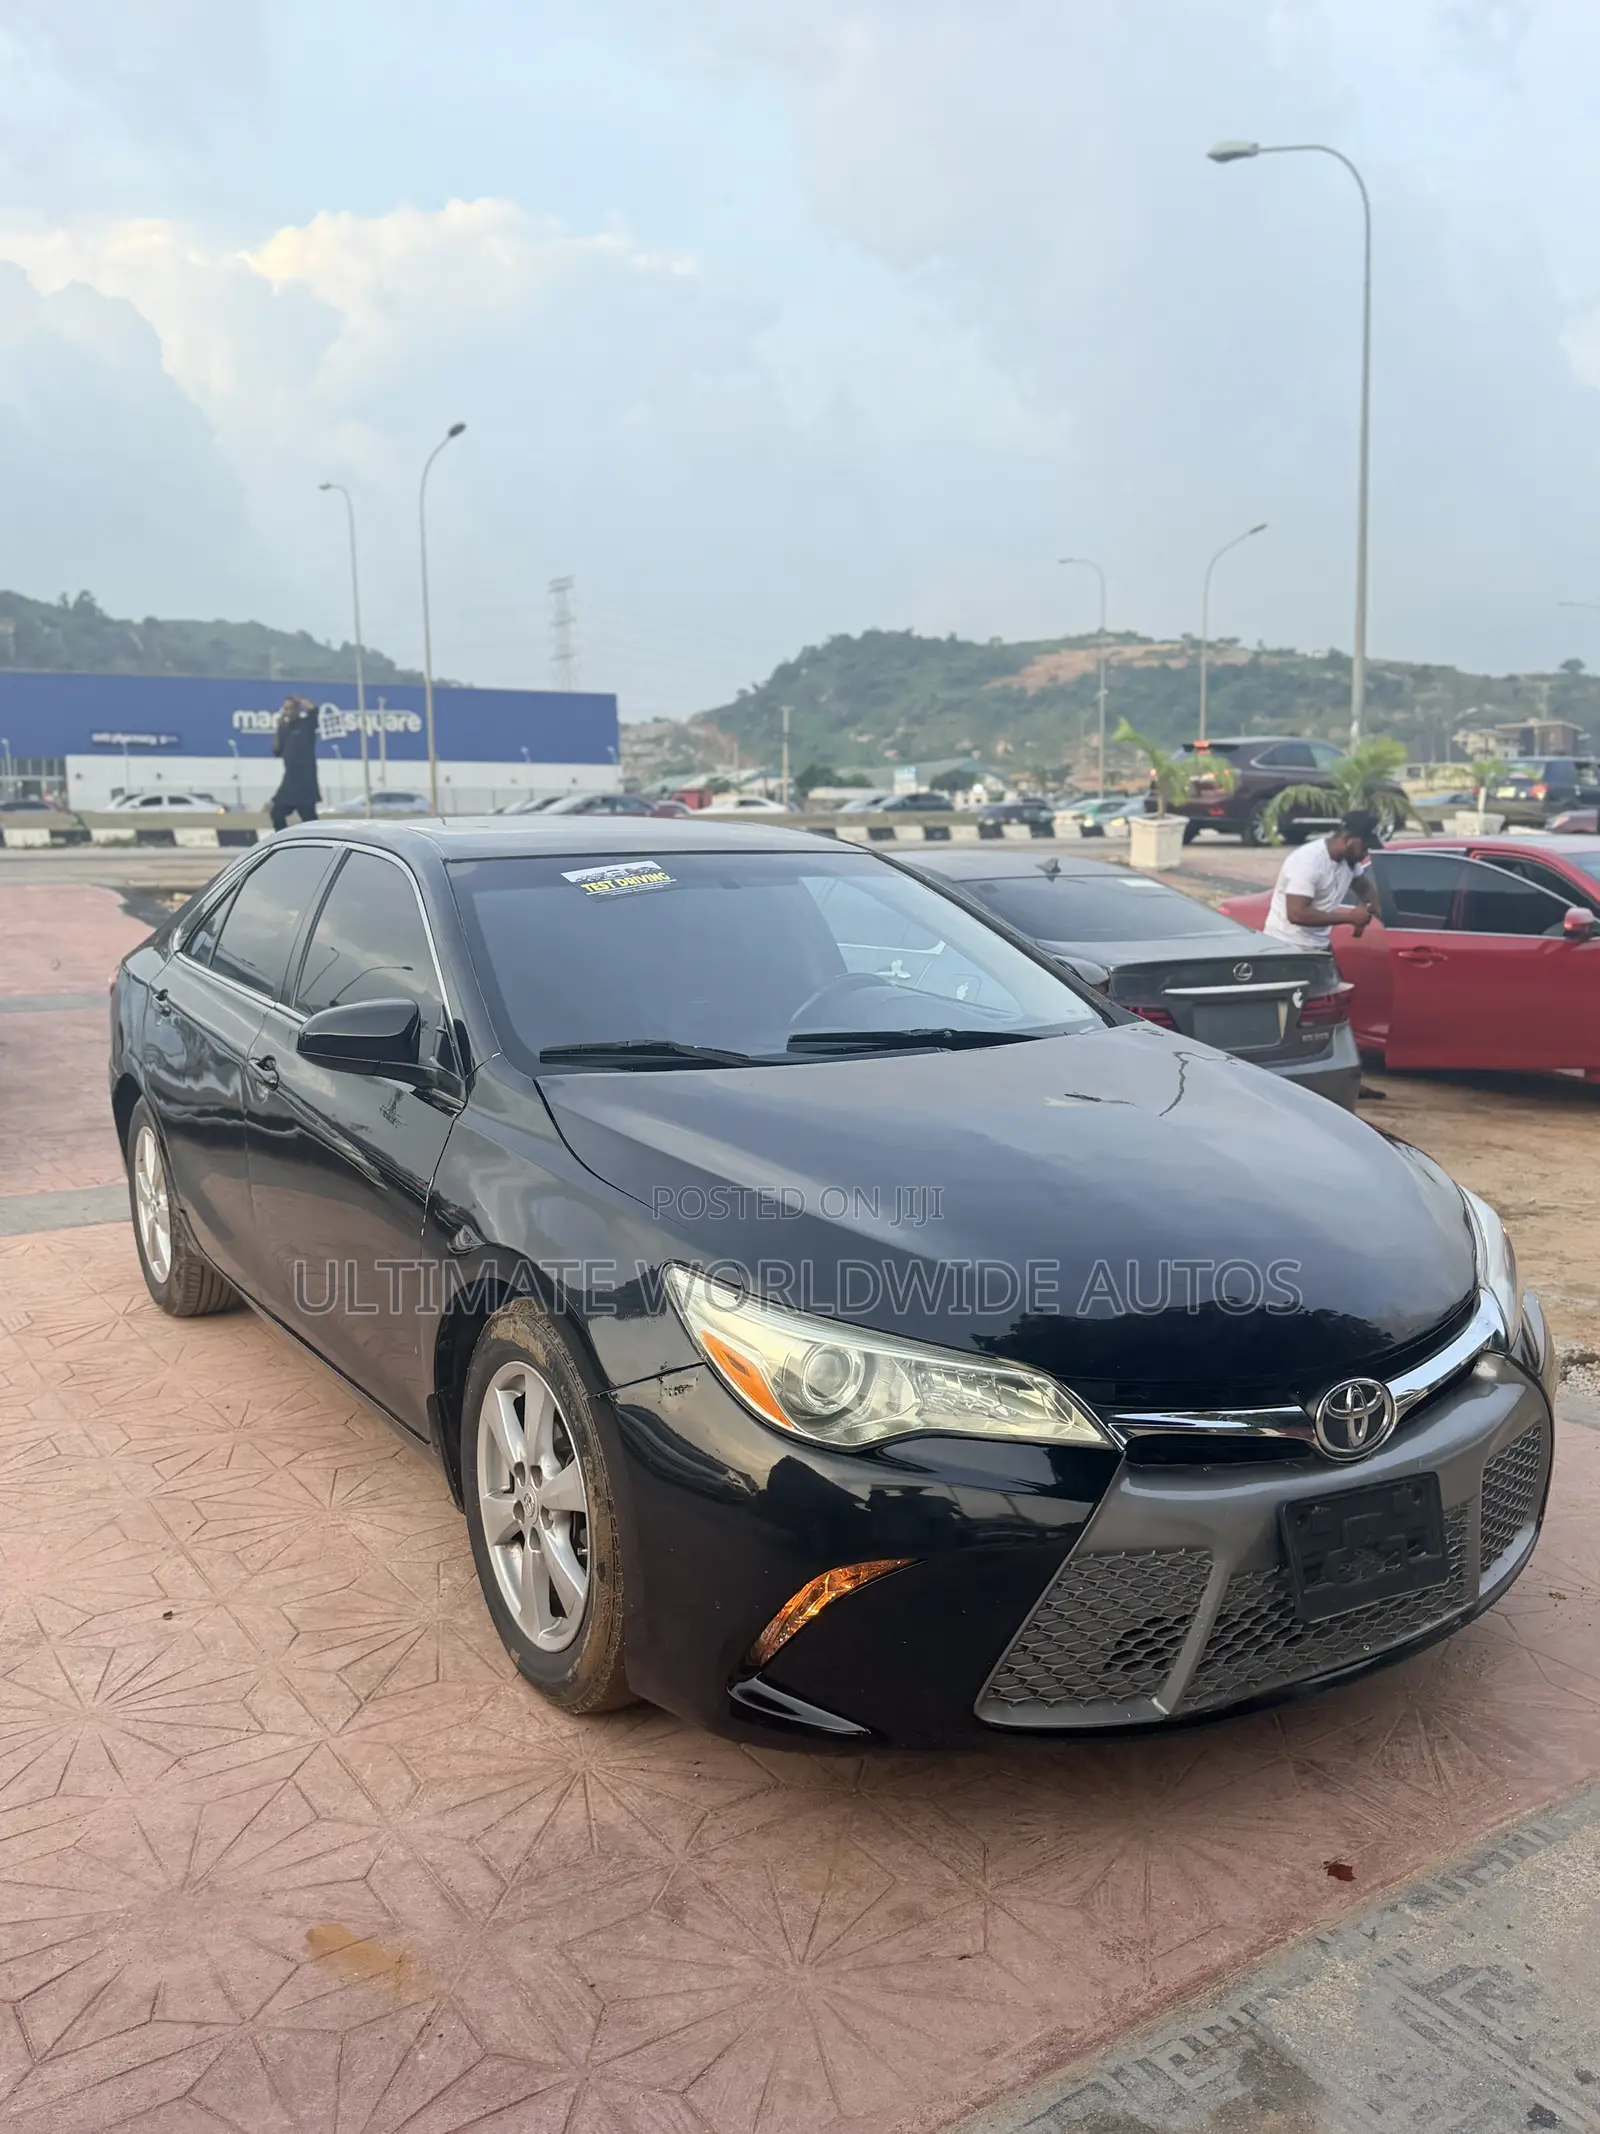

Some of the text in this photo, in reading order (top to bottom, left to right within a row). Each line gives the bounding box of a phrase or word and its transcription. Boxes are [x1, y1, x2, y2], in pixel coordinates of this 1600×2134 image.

[342, 710, 422, 737] square
[580, 880, 616, 892] TEST
[615, 872, 671, 887] DRIVING
